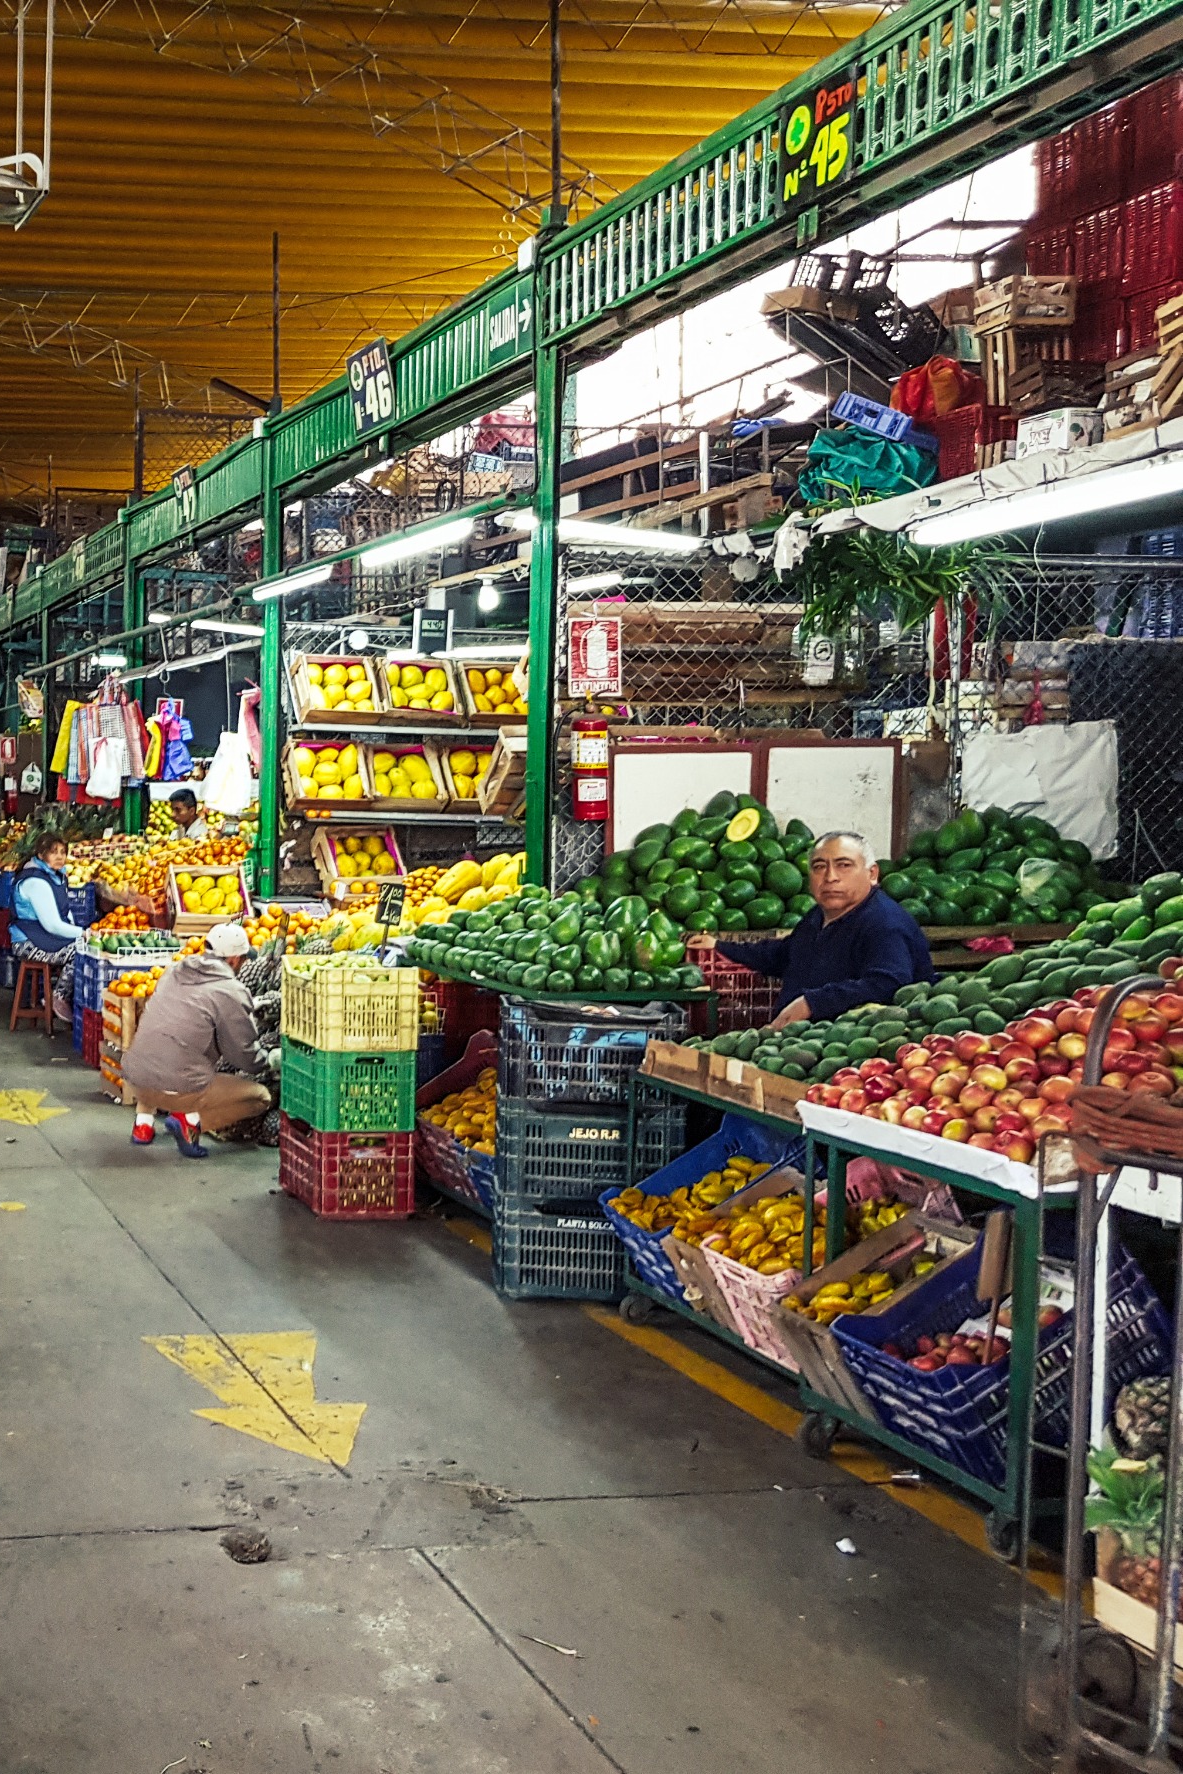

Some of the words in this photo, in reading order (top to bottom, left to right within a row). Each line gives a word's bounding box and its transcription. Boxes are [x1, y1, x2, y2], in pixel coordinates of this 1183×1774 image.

[815, 82, 853, 124] PSTO
[809, 112, 850, 187] 45
[489, 304, 516, 351] SALIDA
[365, 371, 392, 422] 46
[569, 1127, 599, 1139] JEJO
